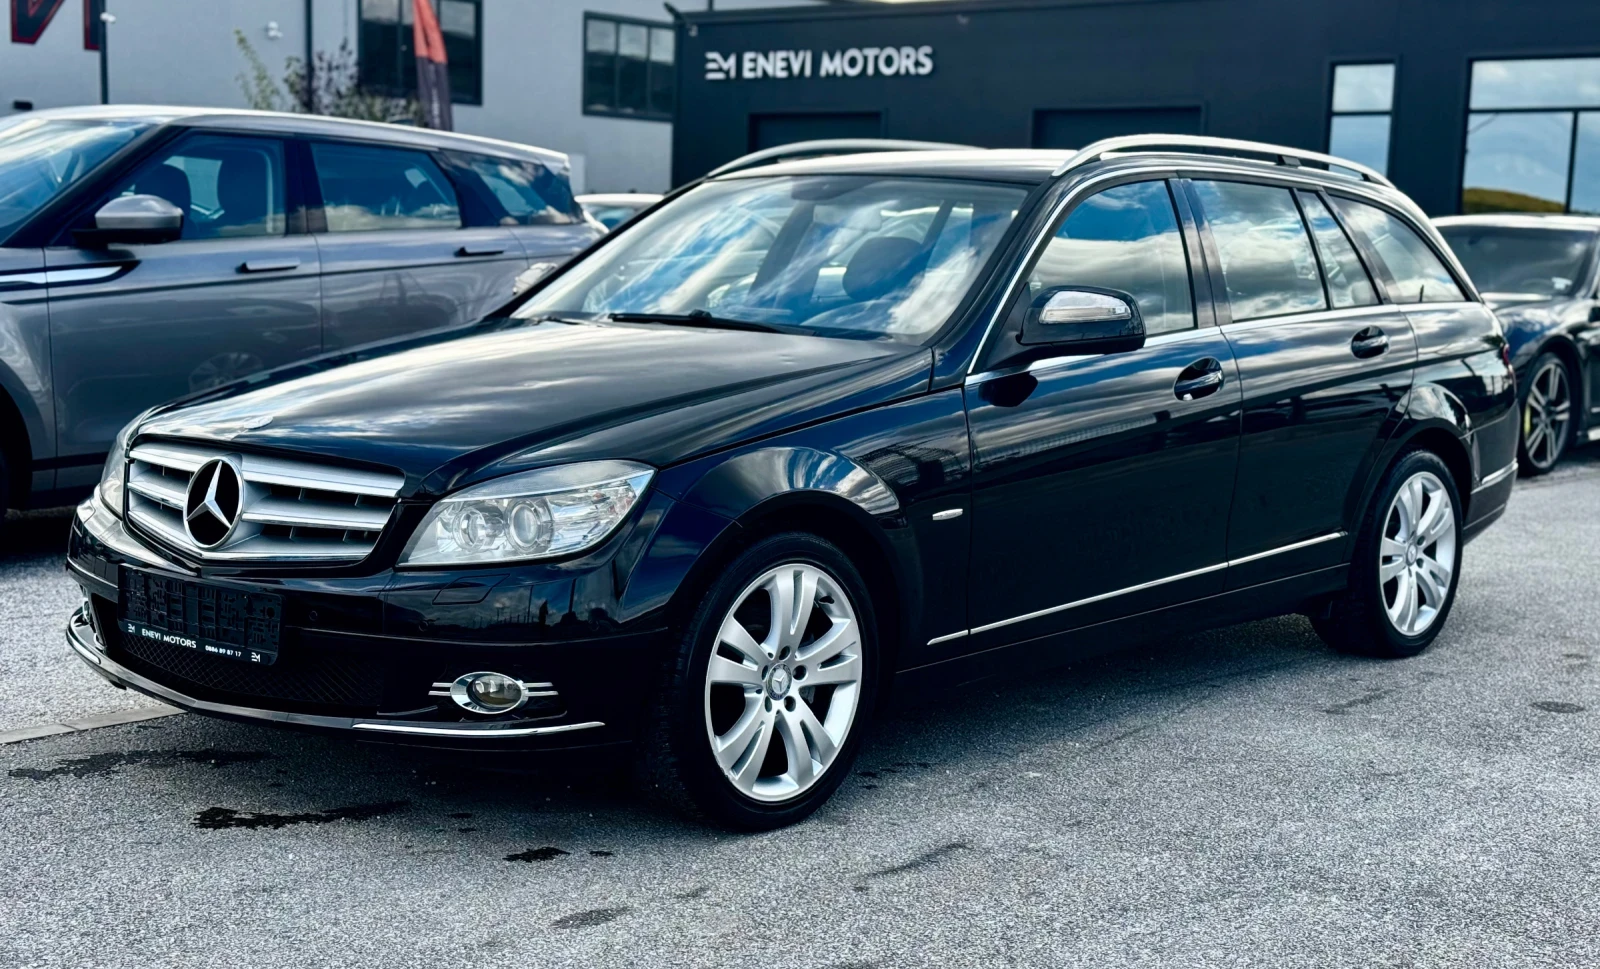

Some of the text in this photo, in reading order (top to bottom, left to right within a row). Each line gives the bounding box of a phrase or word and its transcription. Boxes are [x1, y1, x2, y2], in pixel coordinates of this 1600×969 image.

[742, 50, 812, 79] ENEVI
[819, 46, 933, 78] MOTORS
[141, 628, 161, 640] ENEVI
[163, 634, 197, 649] MOTORS
